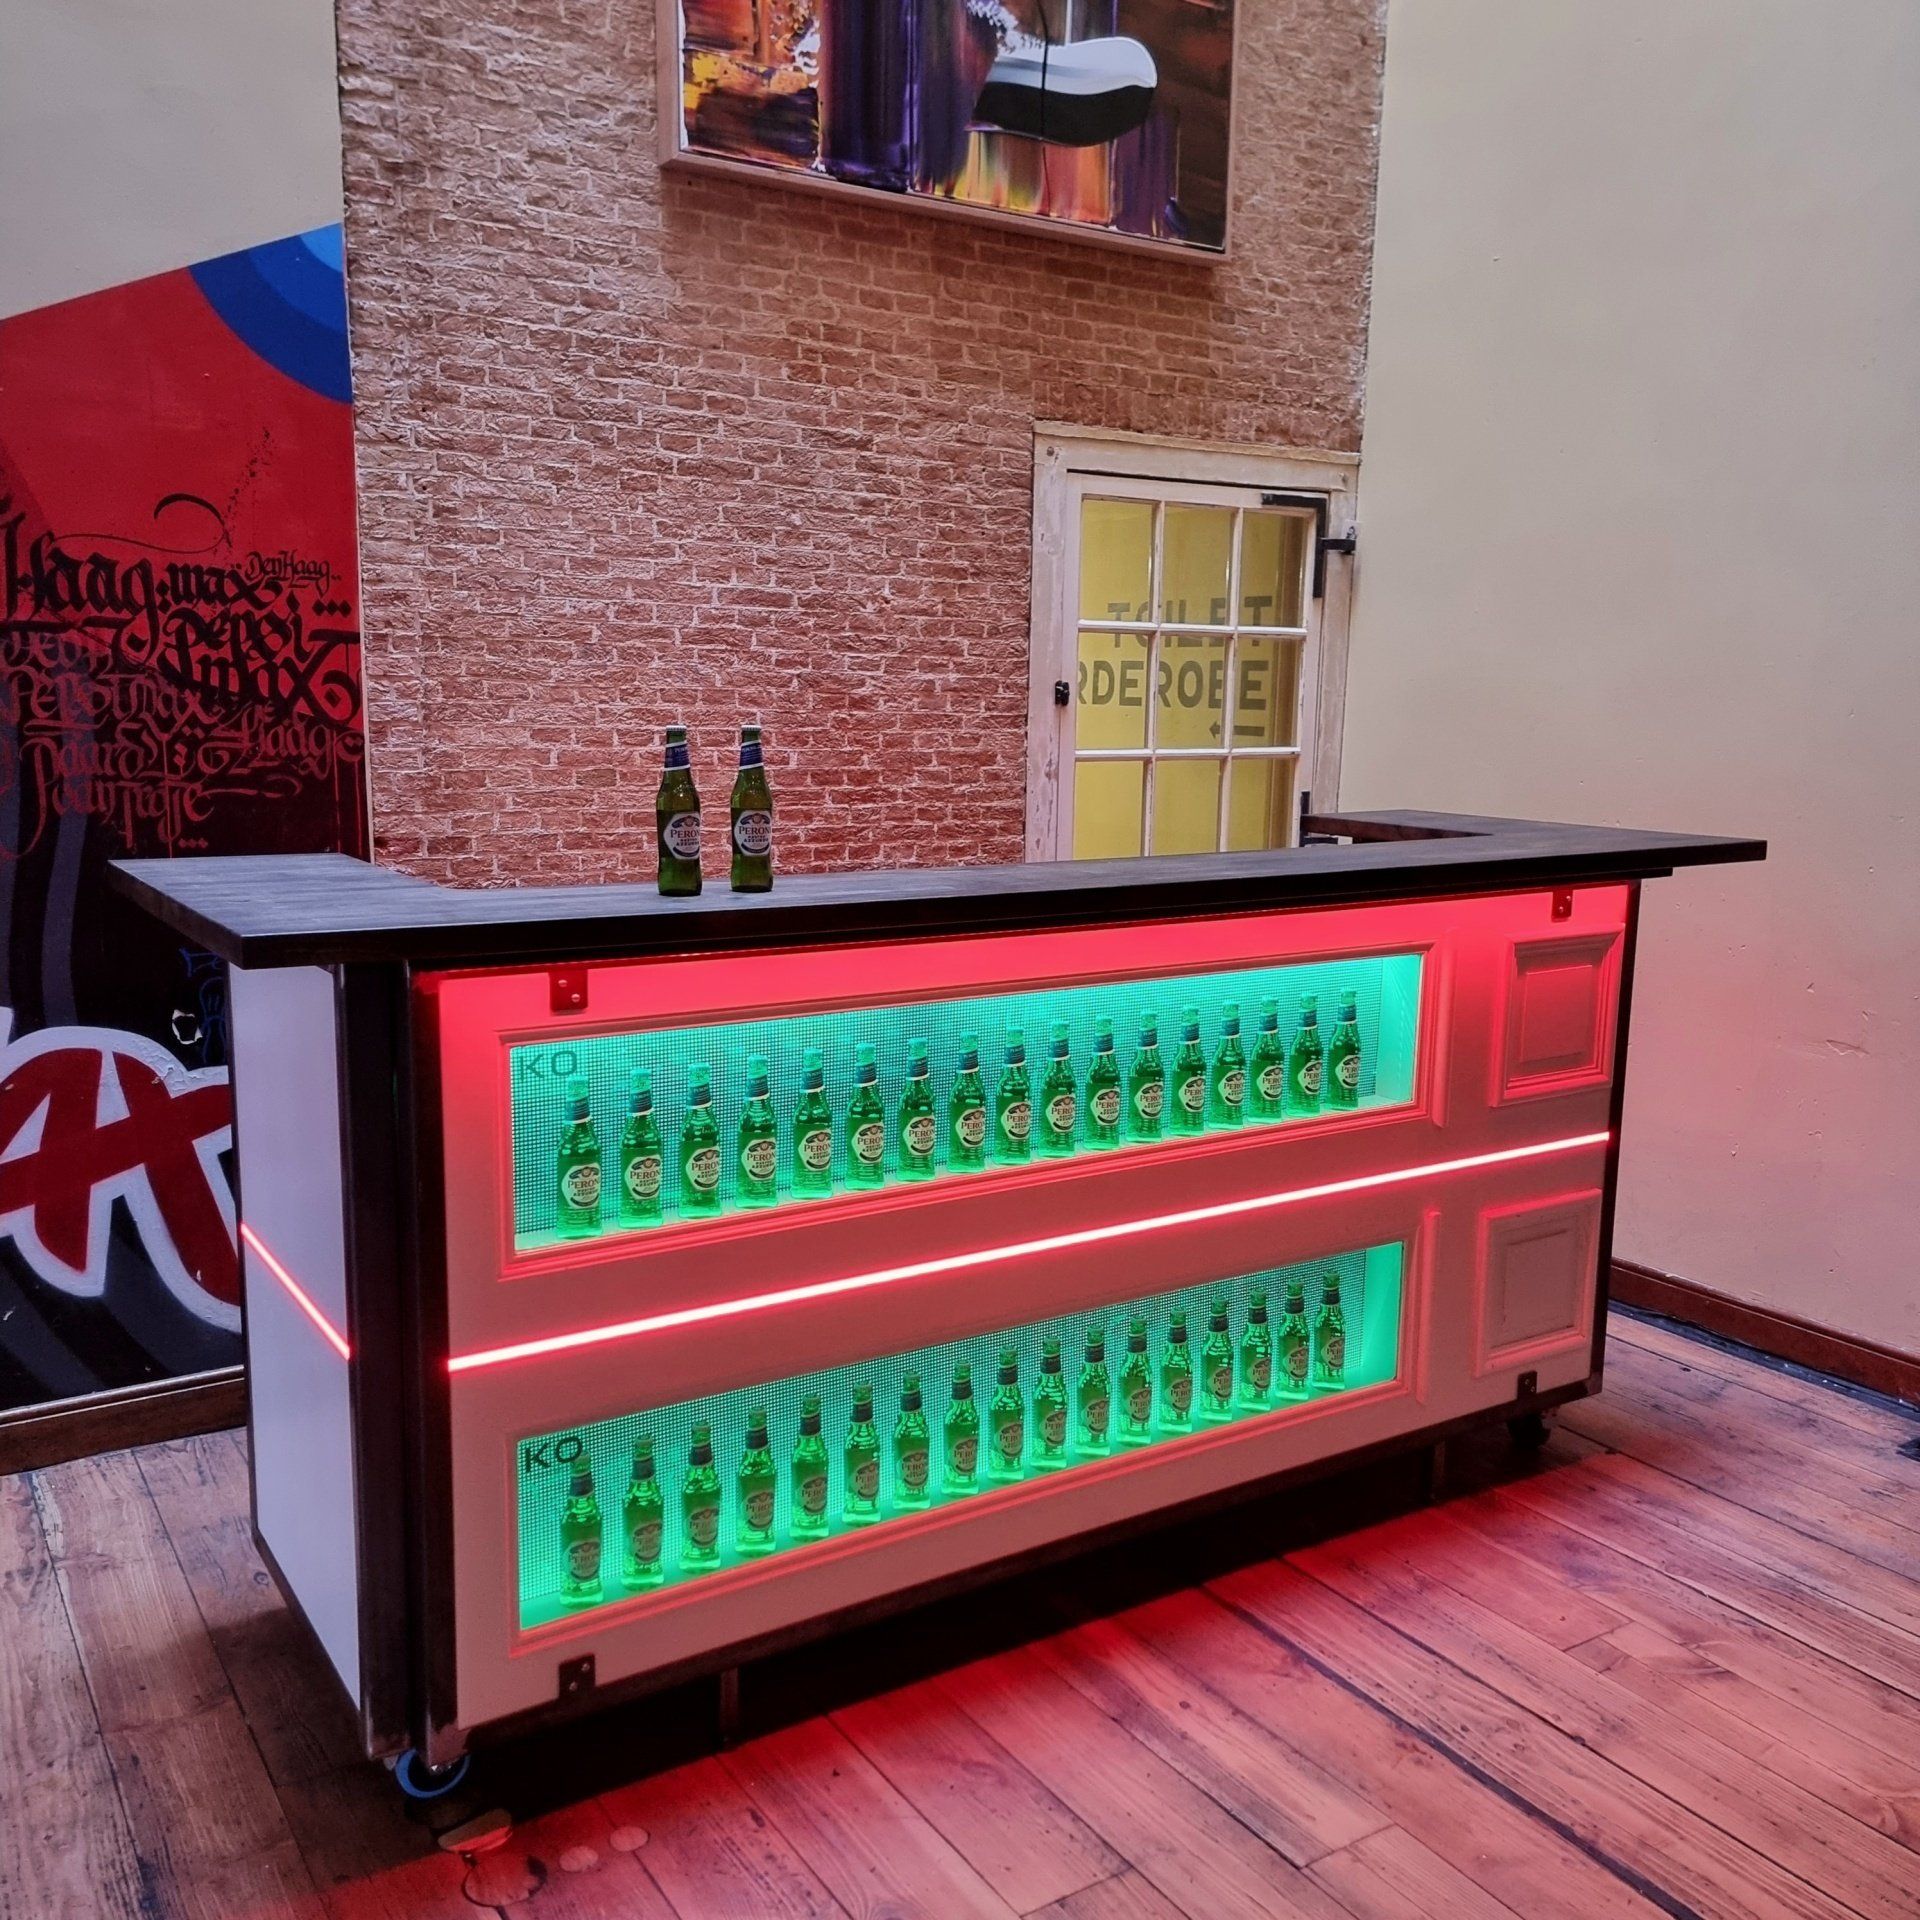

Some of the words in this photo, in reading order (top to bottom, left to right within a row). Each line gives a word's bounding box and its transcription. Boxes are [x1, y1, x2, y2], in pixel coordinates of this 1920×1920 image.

[670, 829, 700, 839] PERON
[737, 826, 770, 835] PERON
[746, 1152, 776, 1162] PERON
[630, 1170, 660, 1179] PERON
[567, 1178, 599, 1189] PERON
[524, 1436, 583, 1473] KO
